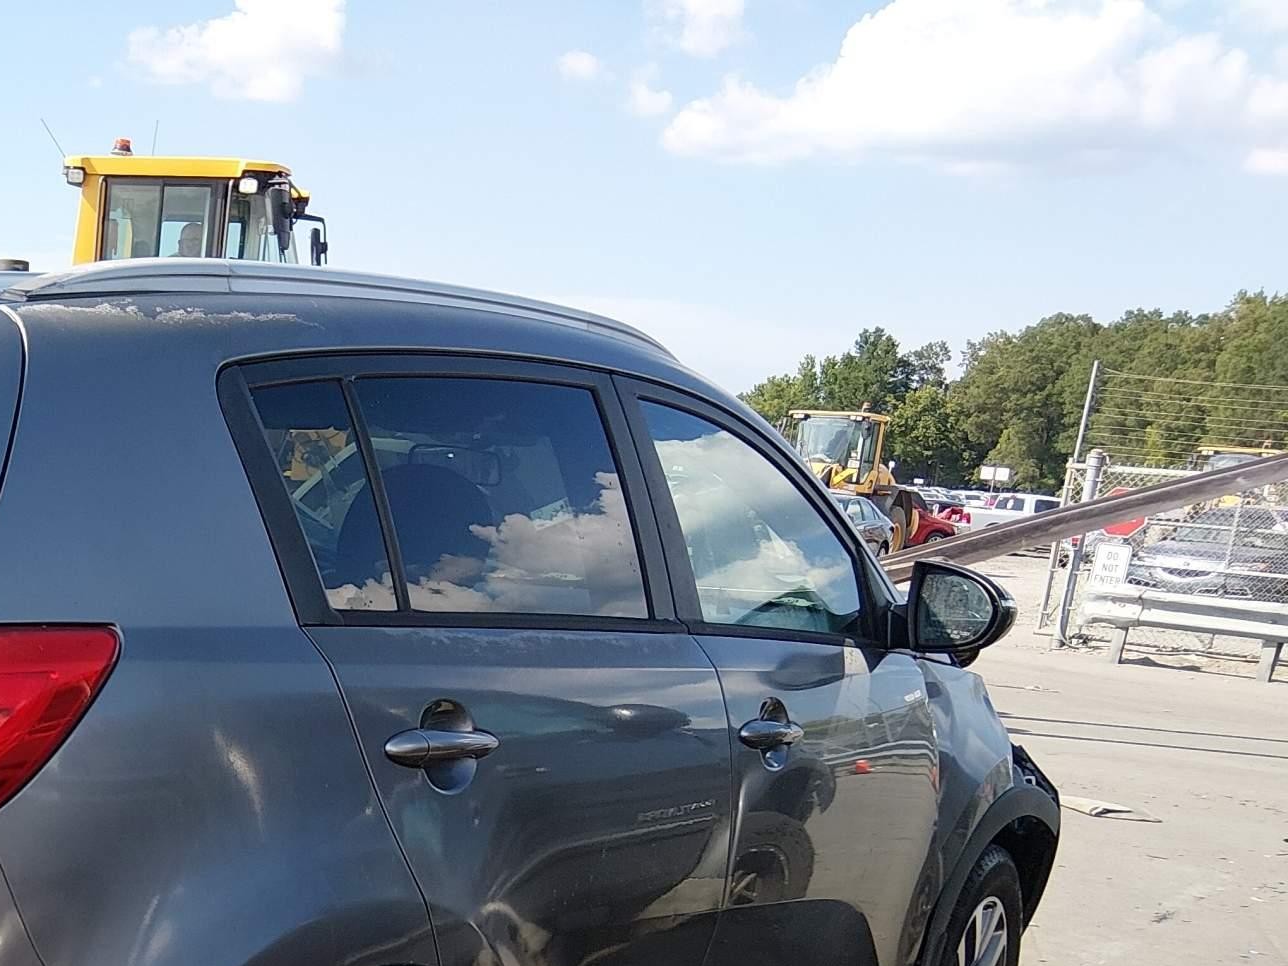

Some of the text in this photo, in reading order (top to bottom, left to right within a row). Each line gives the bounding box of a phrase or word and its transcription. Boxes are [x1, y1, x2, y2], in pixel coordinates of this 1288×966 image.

[1106, 551, 1119, 561] DO
[1102, 563, 1120, 573] NOT
[1094, 574, 1121, 585] ENTER
